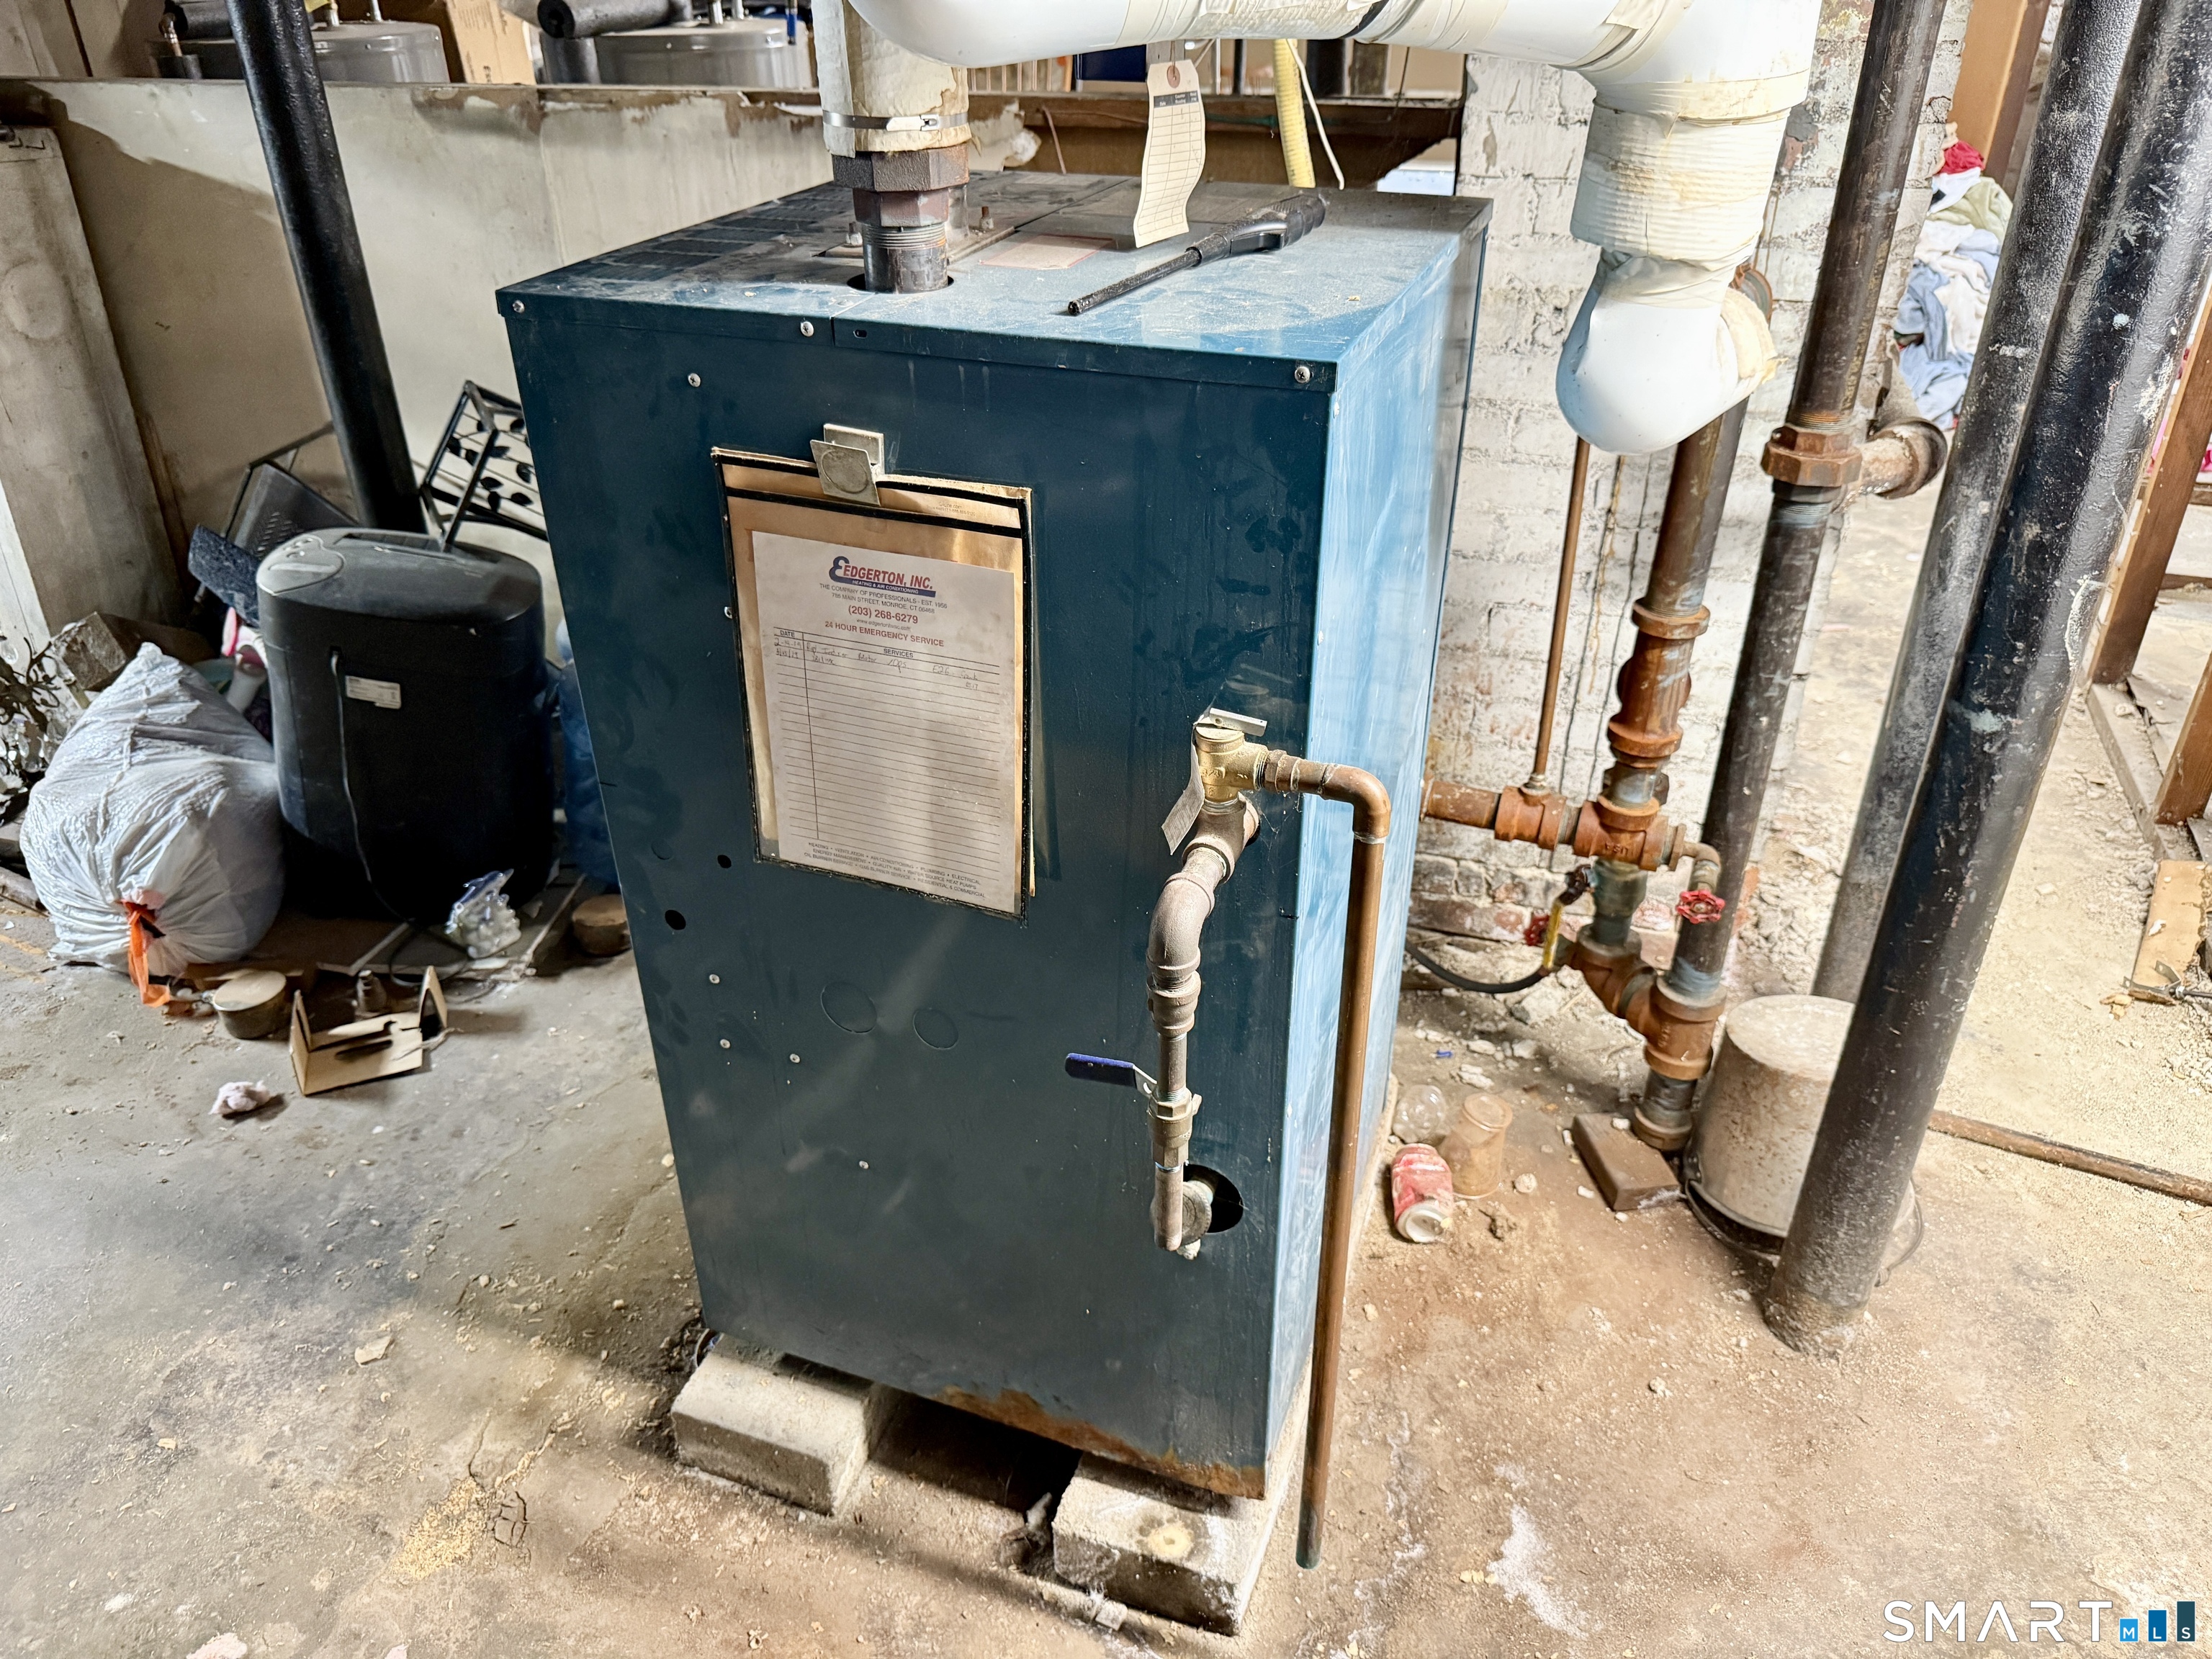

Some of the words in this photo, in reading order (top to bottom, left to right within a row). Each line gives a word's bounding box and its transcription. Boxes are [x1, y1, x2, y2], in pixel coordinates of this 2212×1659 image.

[843, 565, 907, 588] EDGERTON,
[909, 575, 932, 590] INC.
[831, 585, 858, 594] COMPANY
[869, 591, 917, 604] PROFESSIONALS
[885, 585, 919, 595] CONDITIONING
[848, 605, 872, 619] (203)
[874, 609, 918, 624] 268-6279
[780, 629, 795, 638] DATE
[835, 622, 858, 633] HOUR
[859, 626, 908, 642] EMERGENCY
[910, 635, 945, 647] SERVICE
[884, 648, 914, 658] SERVICES
[951, 873, 981, 885] ELECTRICAL
